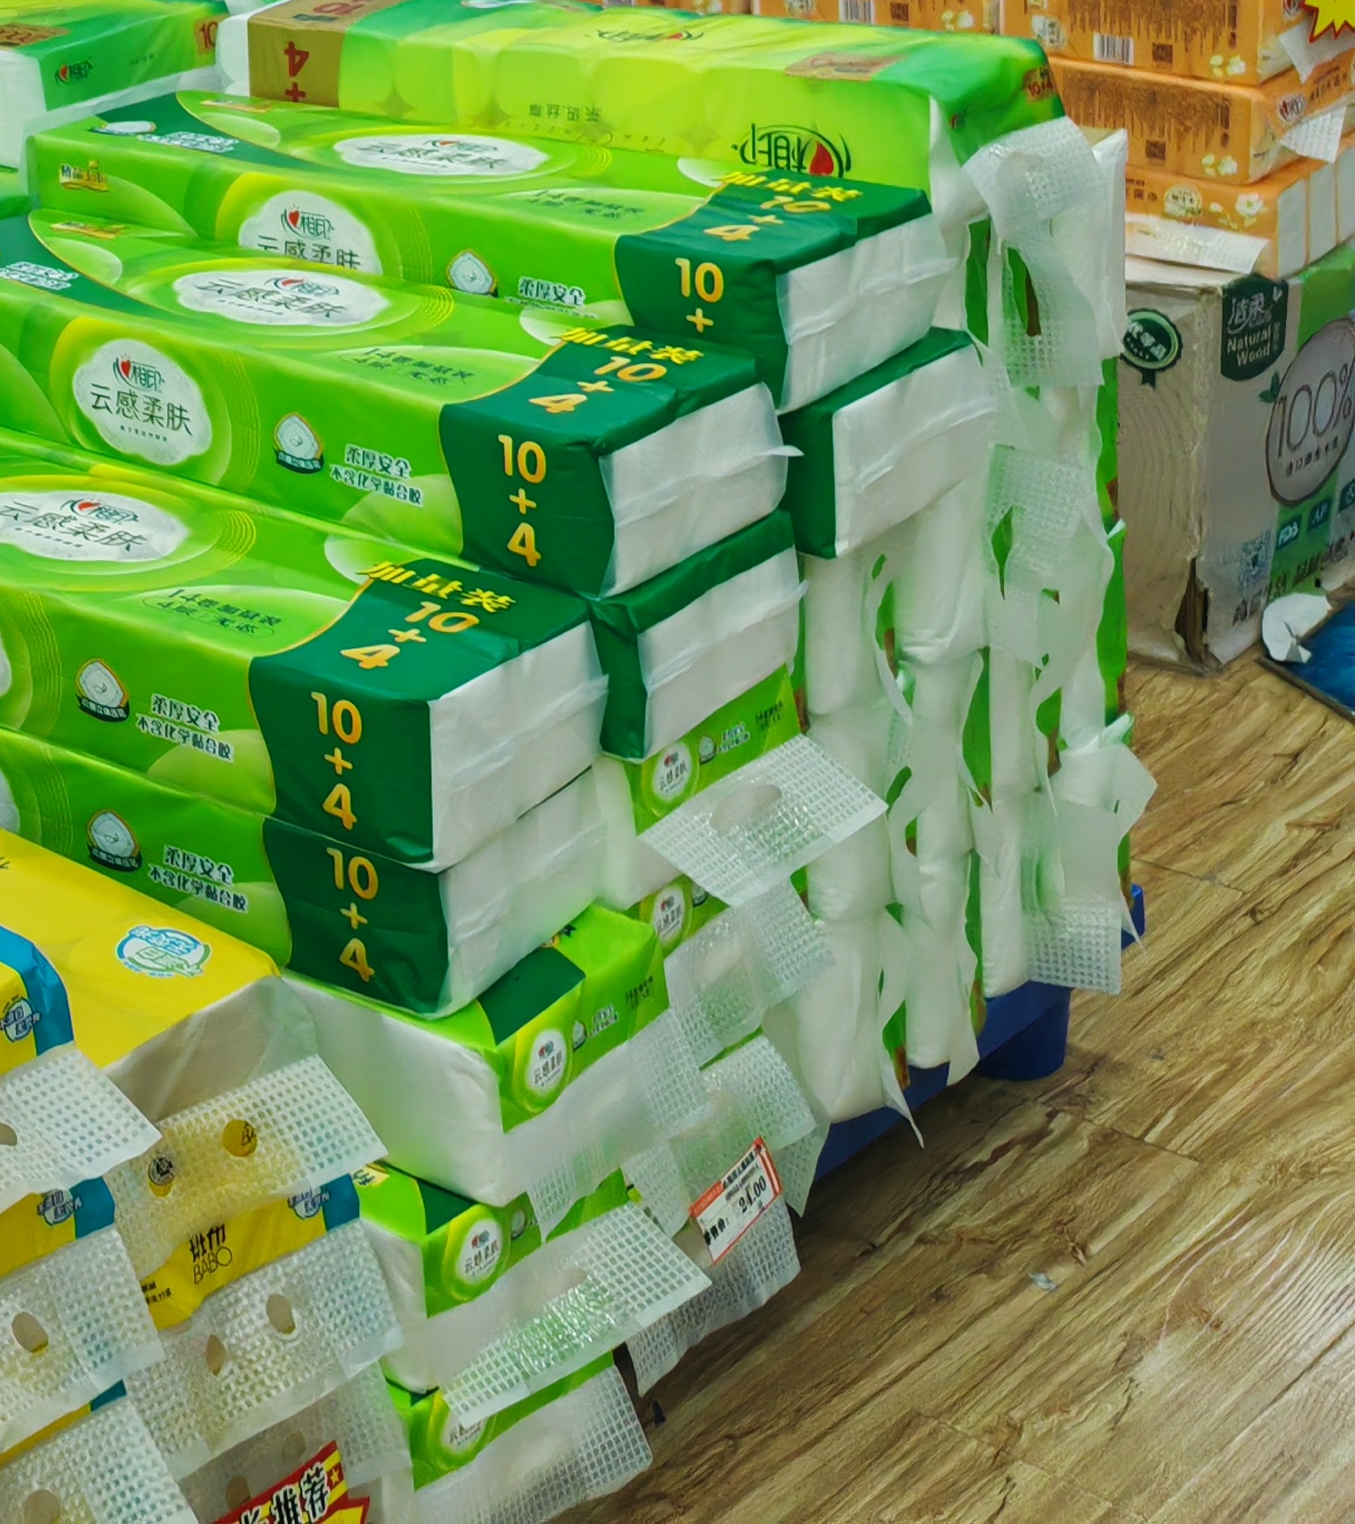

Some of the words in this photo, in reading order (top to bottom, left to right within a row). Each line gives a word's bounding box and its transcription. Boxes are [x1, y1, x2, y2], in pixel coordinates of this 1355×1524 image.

[280, 202, 335, 240] 心相印
[518, 275, 586, 308] 柔厚安全
[1227, 328, 1272, 353] Natural
[112, 352, 165, 393] 心相印
[89, 382, 194, 437] 云感柔肤
[345, 444, 411, 479] 柔厚安全
[354, 560, 517, 613] 加量装
[151, 693, 221, 734] 柔厚安全
[163, 844, 234, 886] 柔厚安全
[192, 1245, 234, 1285] BABO
